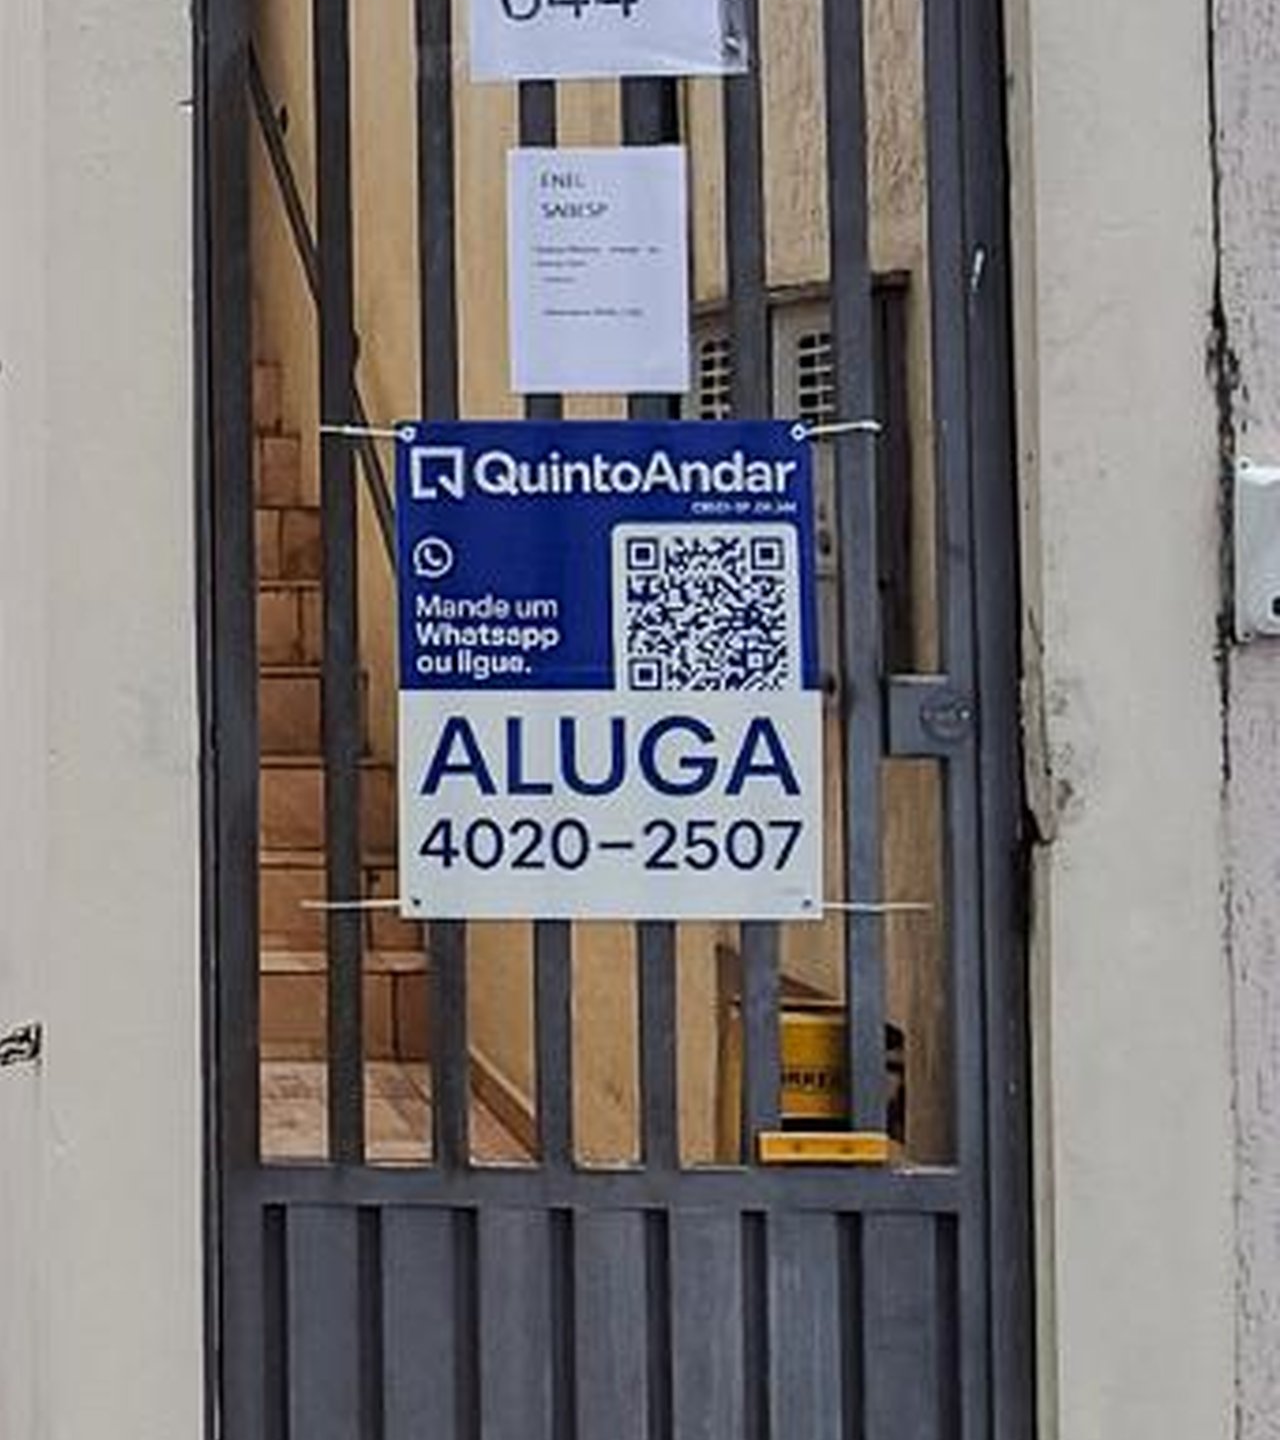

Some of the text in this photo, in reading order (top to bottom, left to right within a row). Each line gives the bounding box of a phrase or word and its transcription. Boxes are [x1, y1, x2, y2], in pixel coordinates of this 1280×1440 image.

[473, 451, 797, 496] QuintoAndar
[416, 594, 559, 619] Mande um
[415, 621, 561, 651] Whatsapp
[416, 649, 533, 680] ou ligue.
[420, 715, 802, 796] ALUGA
[419, 818, 804, 870] 4020-2507
